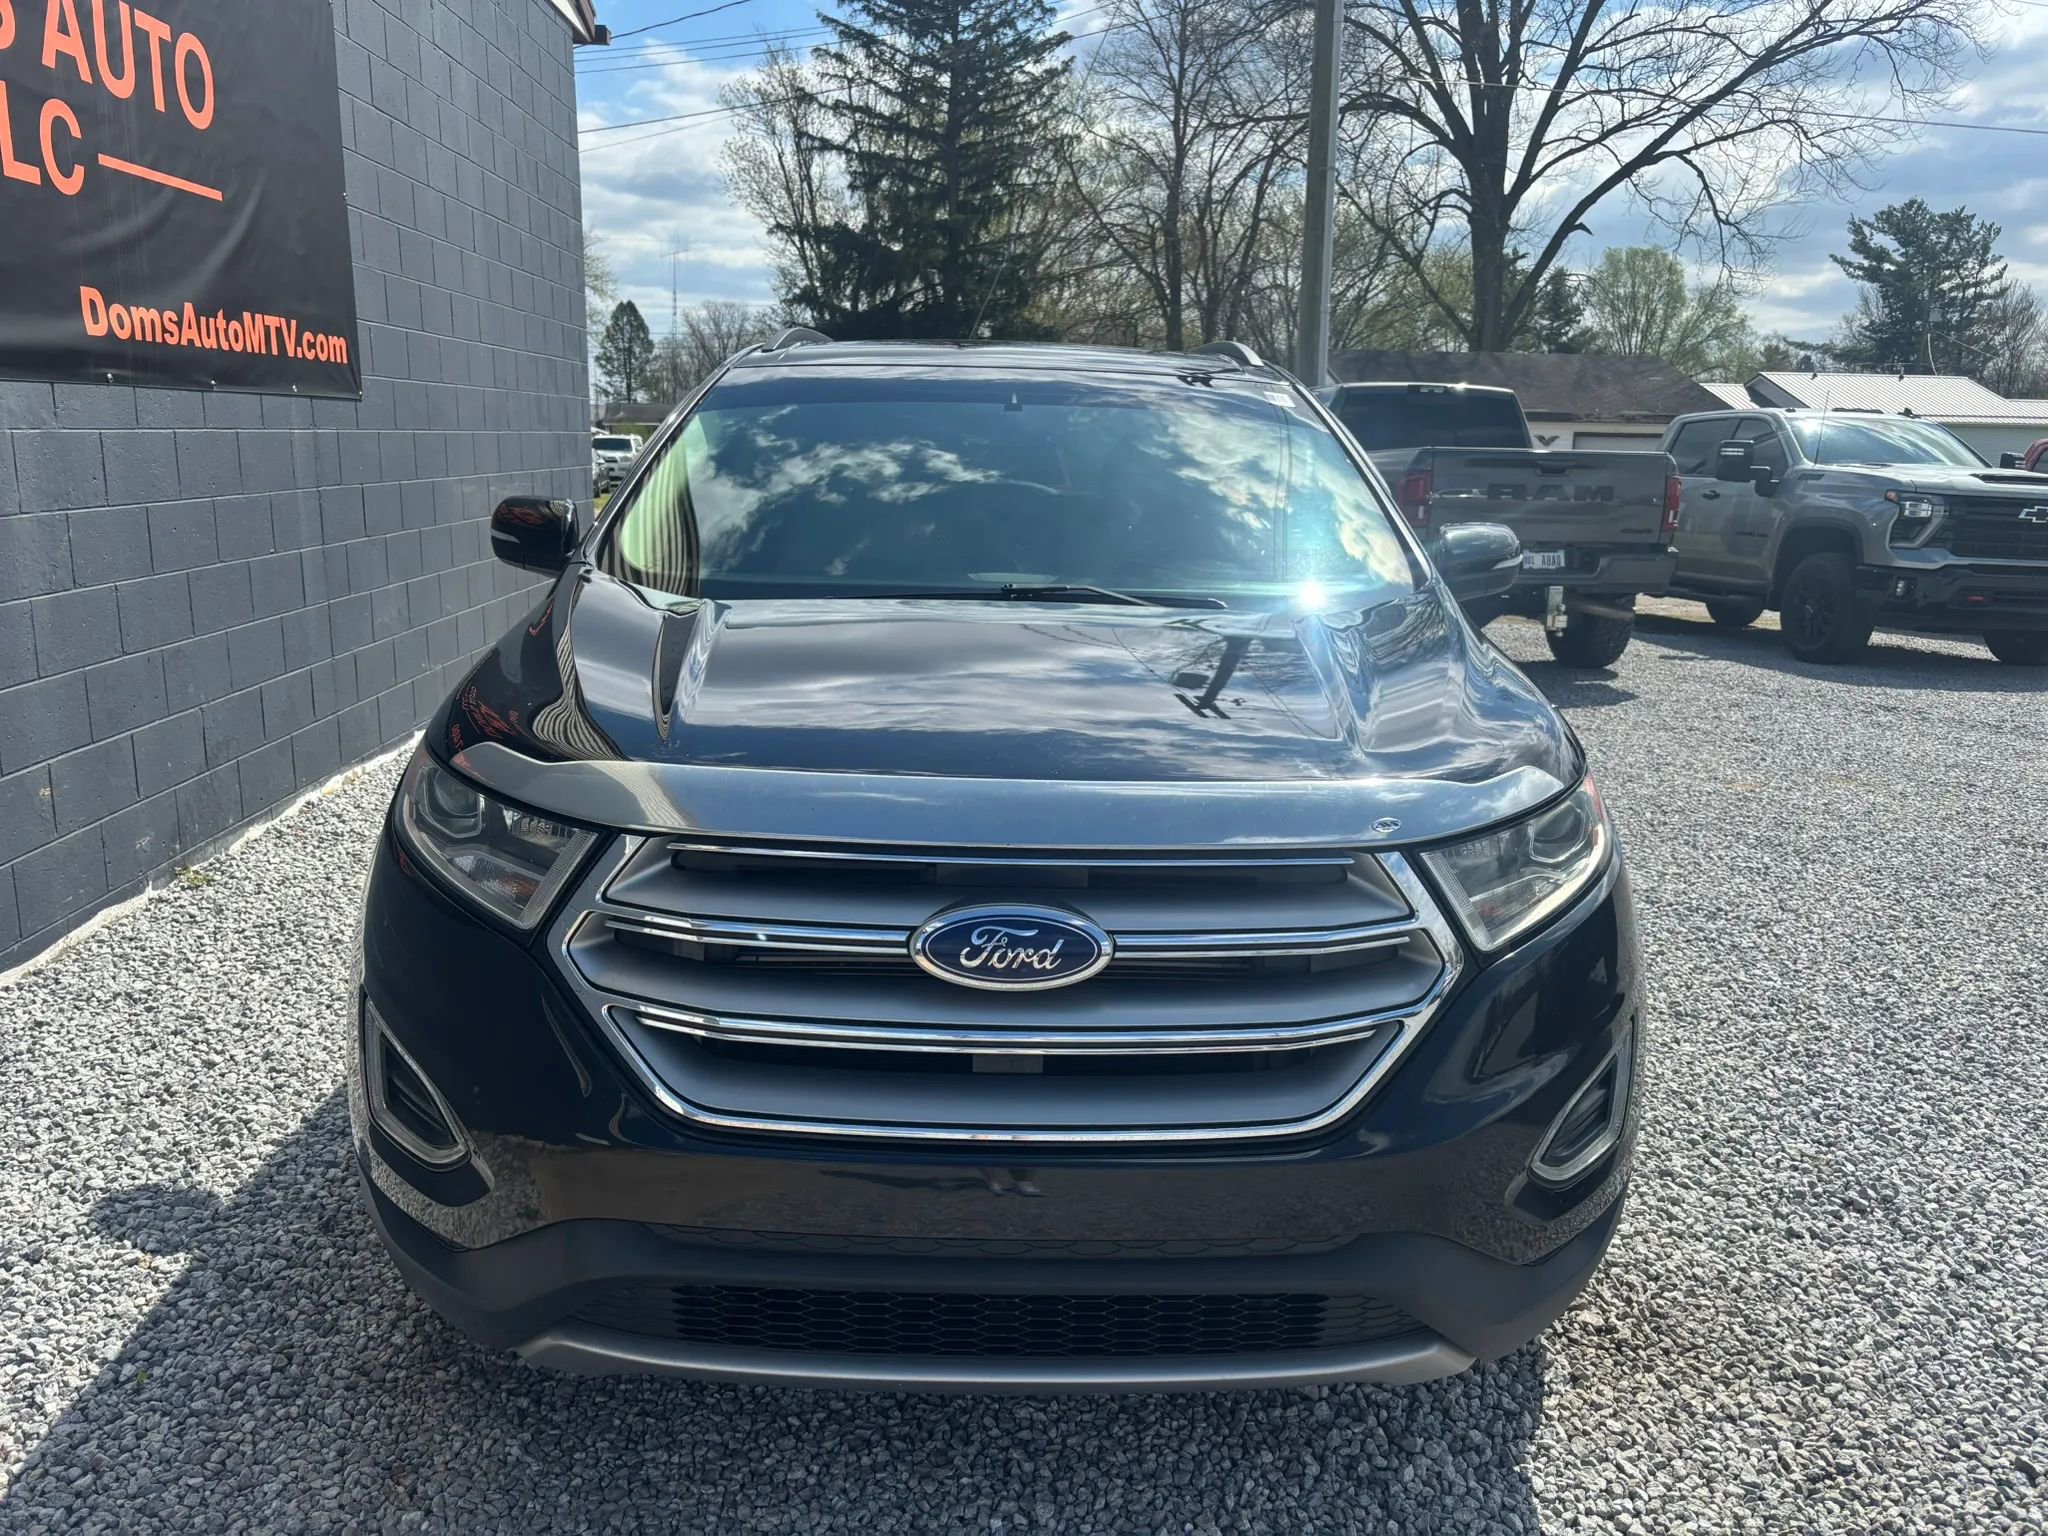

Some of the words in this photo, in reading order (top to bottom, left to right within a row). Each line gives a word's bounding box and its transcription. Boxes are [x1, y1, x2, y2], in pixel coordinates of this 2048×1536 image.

[42, 0, 215, 130] AUTO
[79, 285, 348, 364] DomsAutoMTV.com
[1487, 483, 1615, 501] RAM
[959, 926, 1064, 969] Ford
